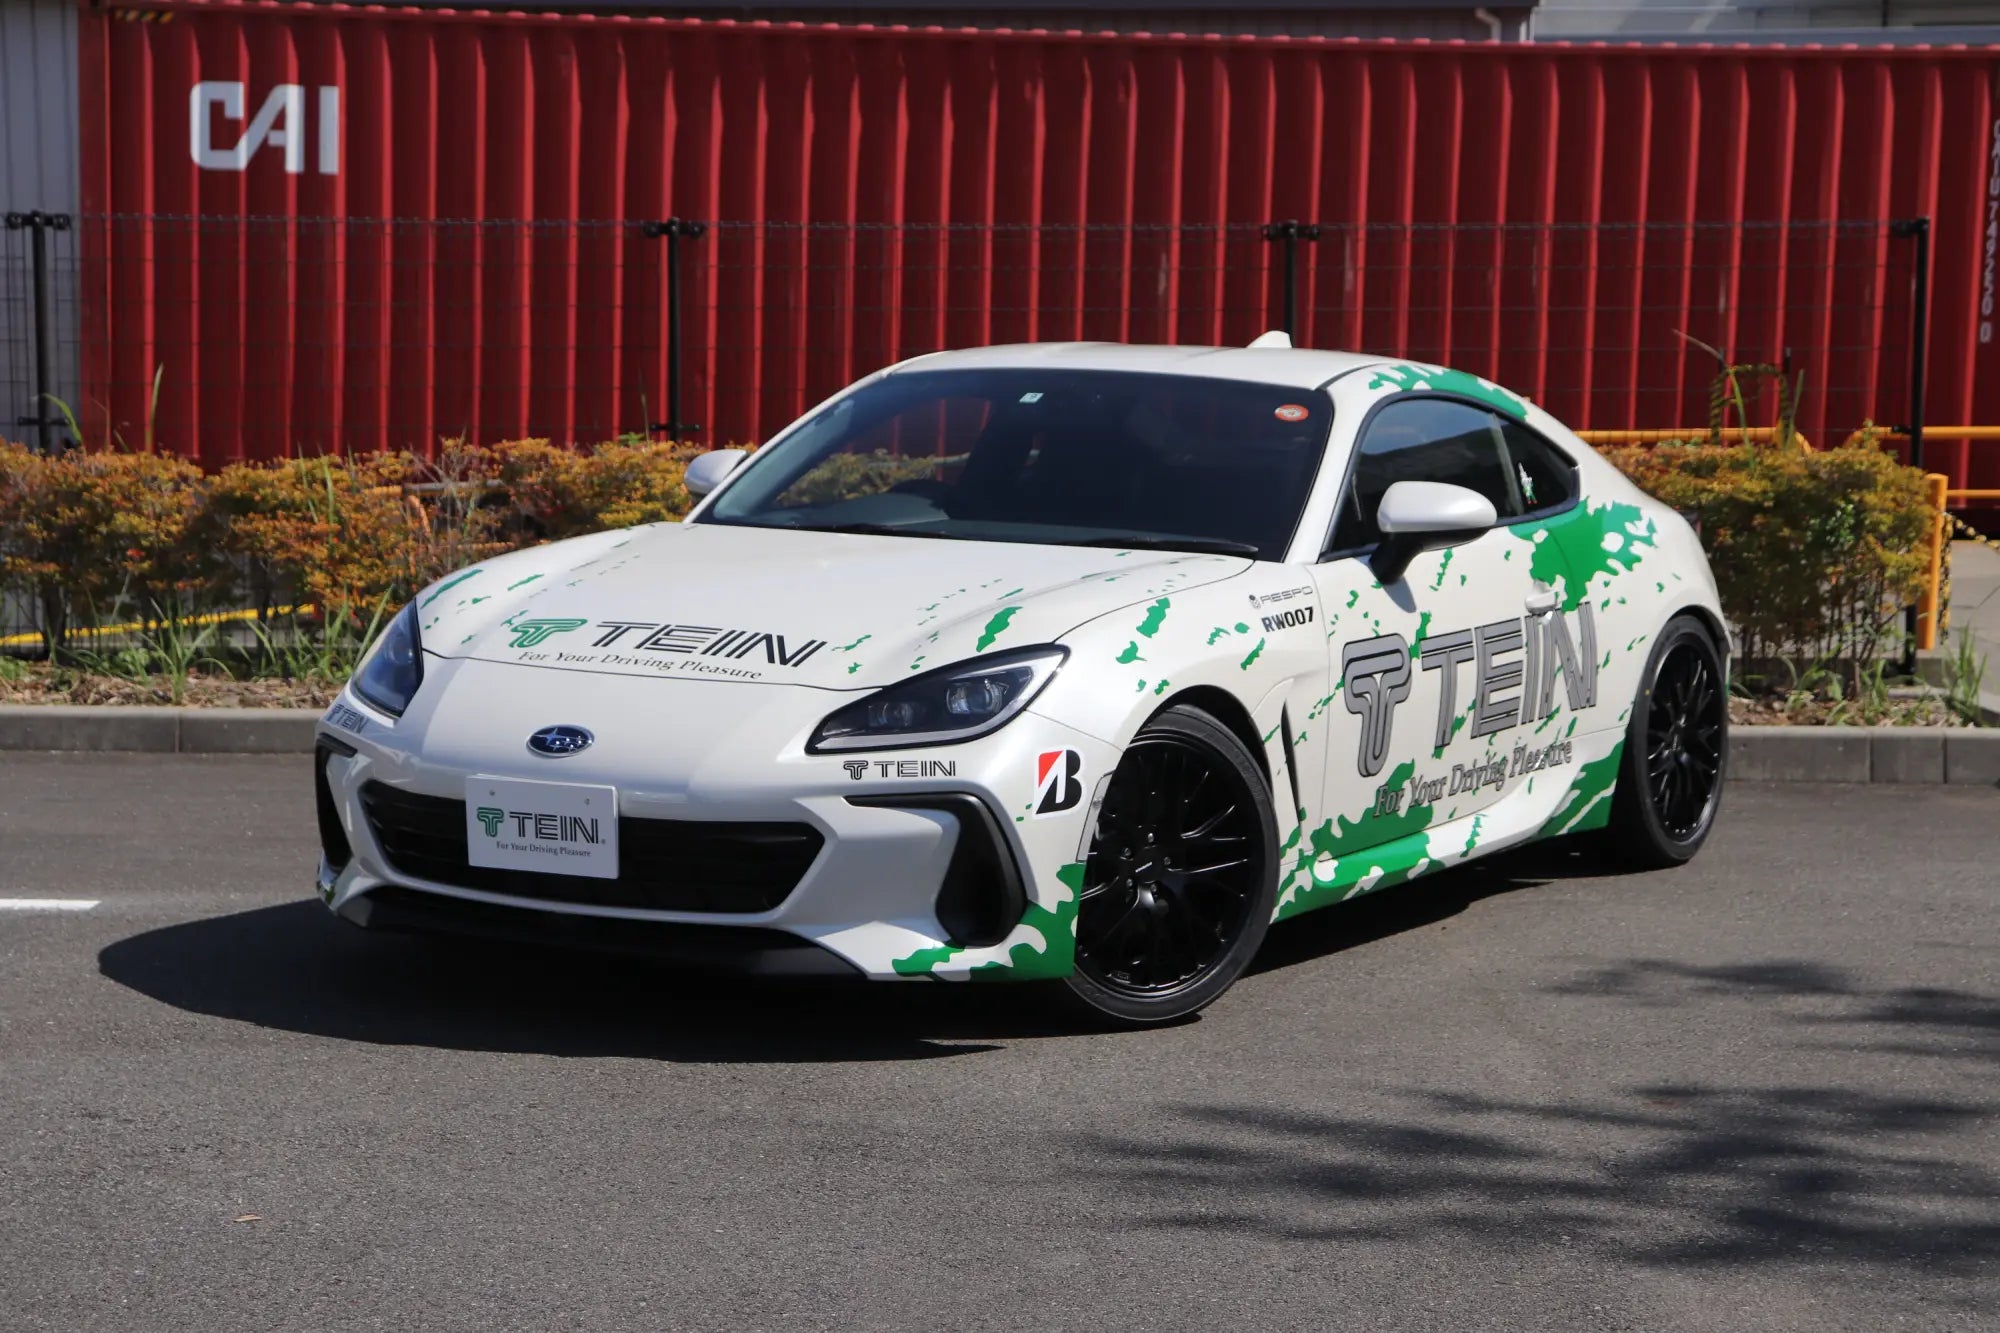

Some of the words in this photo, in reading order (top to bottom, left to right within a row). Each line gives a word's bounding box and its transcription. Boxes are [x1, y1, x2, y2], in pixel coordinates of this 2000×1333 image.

[190, 81, 340, 175] CAI
[1261, 605, 1314, 633] RW007
[591, 620, 828, 668] TEIN
[518, 651, 550, 662] For
[552, 652, 599, 664] Your
[600, 653, 675, 670] Driving
[680, 660, 763, 680] Pleasure
[1419, 601, 1599, 749] TEIN
[874, 760, 956, 778] TEIN
[1373, 783, 1406, 818] For
[1408, 775, 1447, 808] Your
[1448, 752, 1509, 792] Driving
[509, 811, 599, 844] TEIN
[496, 841, 508, 850] For
[511, 842, 527, 852] Your
[529, 844, 558, 856] Driving
[560, 847, 591, 858] Pleasure
